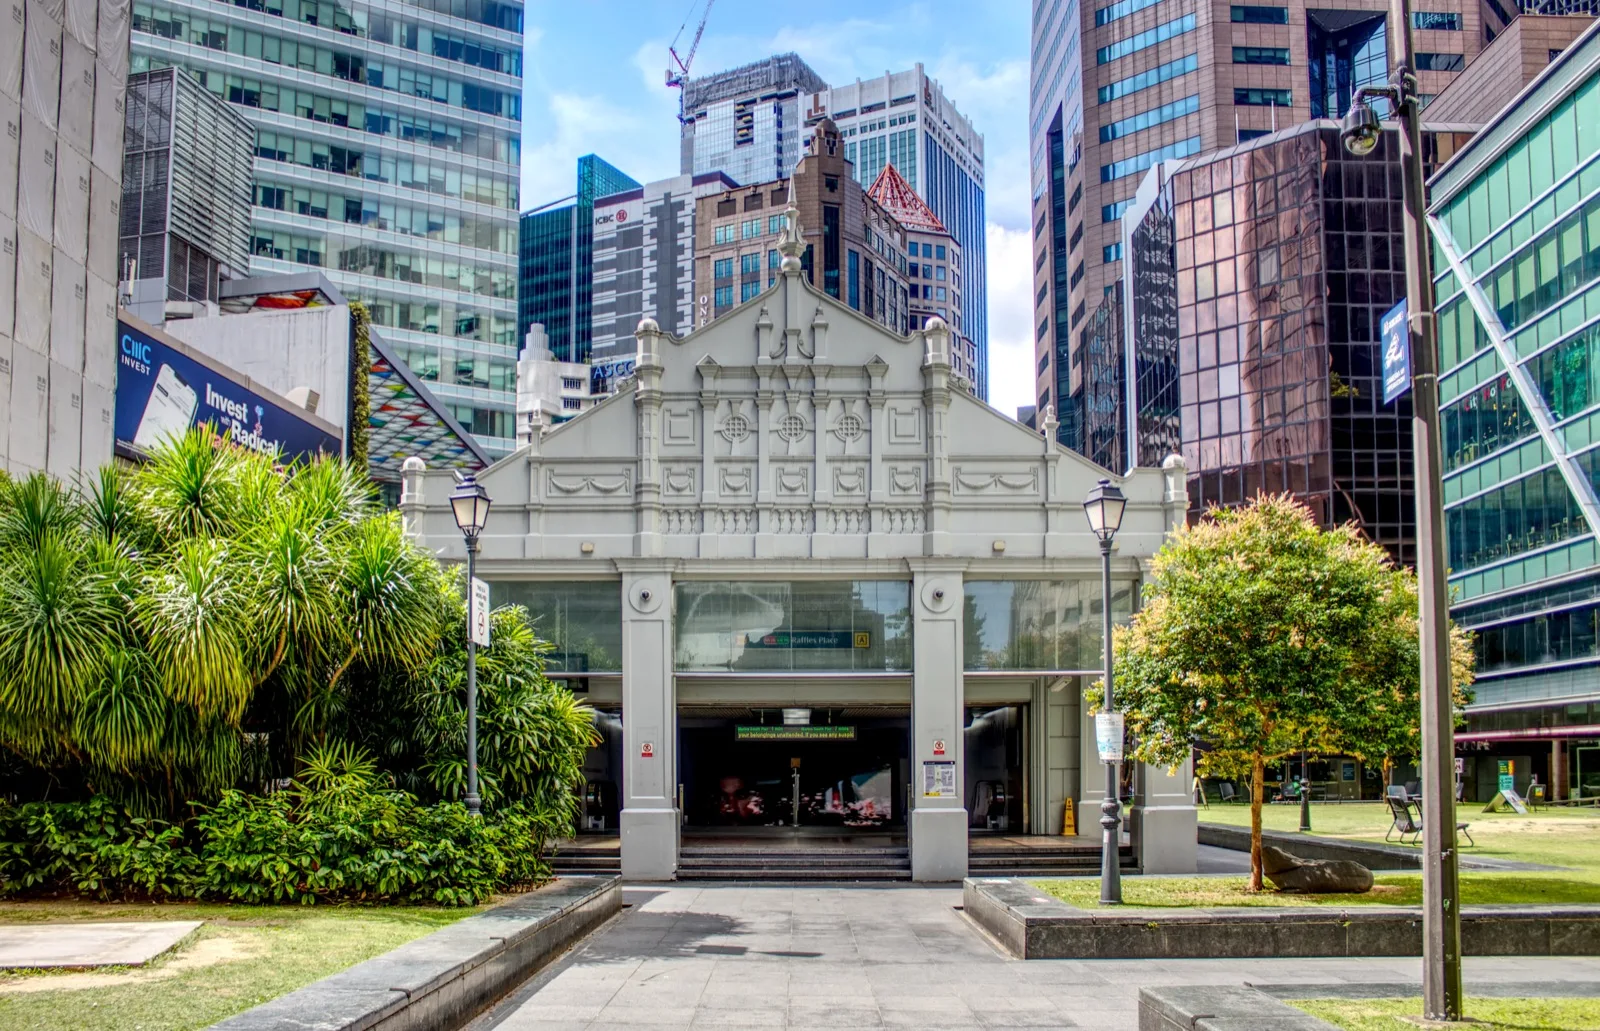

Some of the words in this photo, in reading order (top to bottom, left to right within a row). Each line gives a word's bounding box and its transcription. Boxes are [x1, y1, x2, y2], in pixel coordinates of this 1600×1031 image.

[595, 214, 614, 226] ICBC
[700, 295, 708, 328] ONE
[121, 354, 151, 376] INVEST
[1483, 386, 1496, 402] Ho
[1501, 377, 1513, 391] Po
[206, 383, 248, 424] Invest
[231, 419, 279, 457] Radical
[792, 636, 816, 645] Raffles
[819, 636, 839, 645] Place
